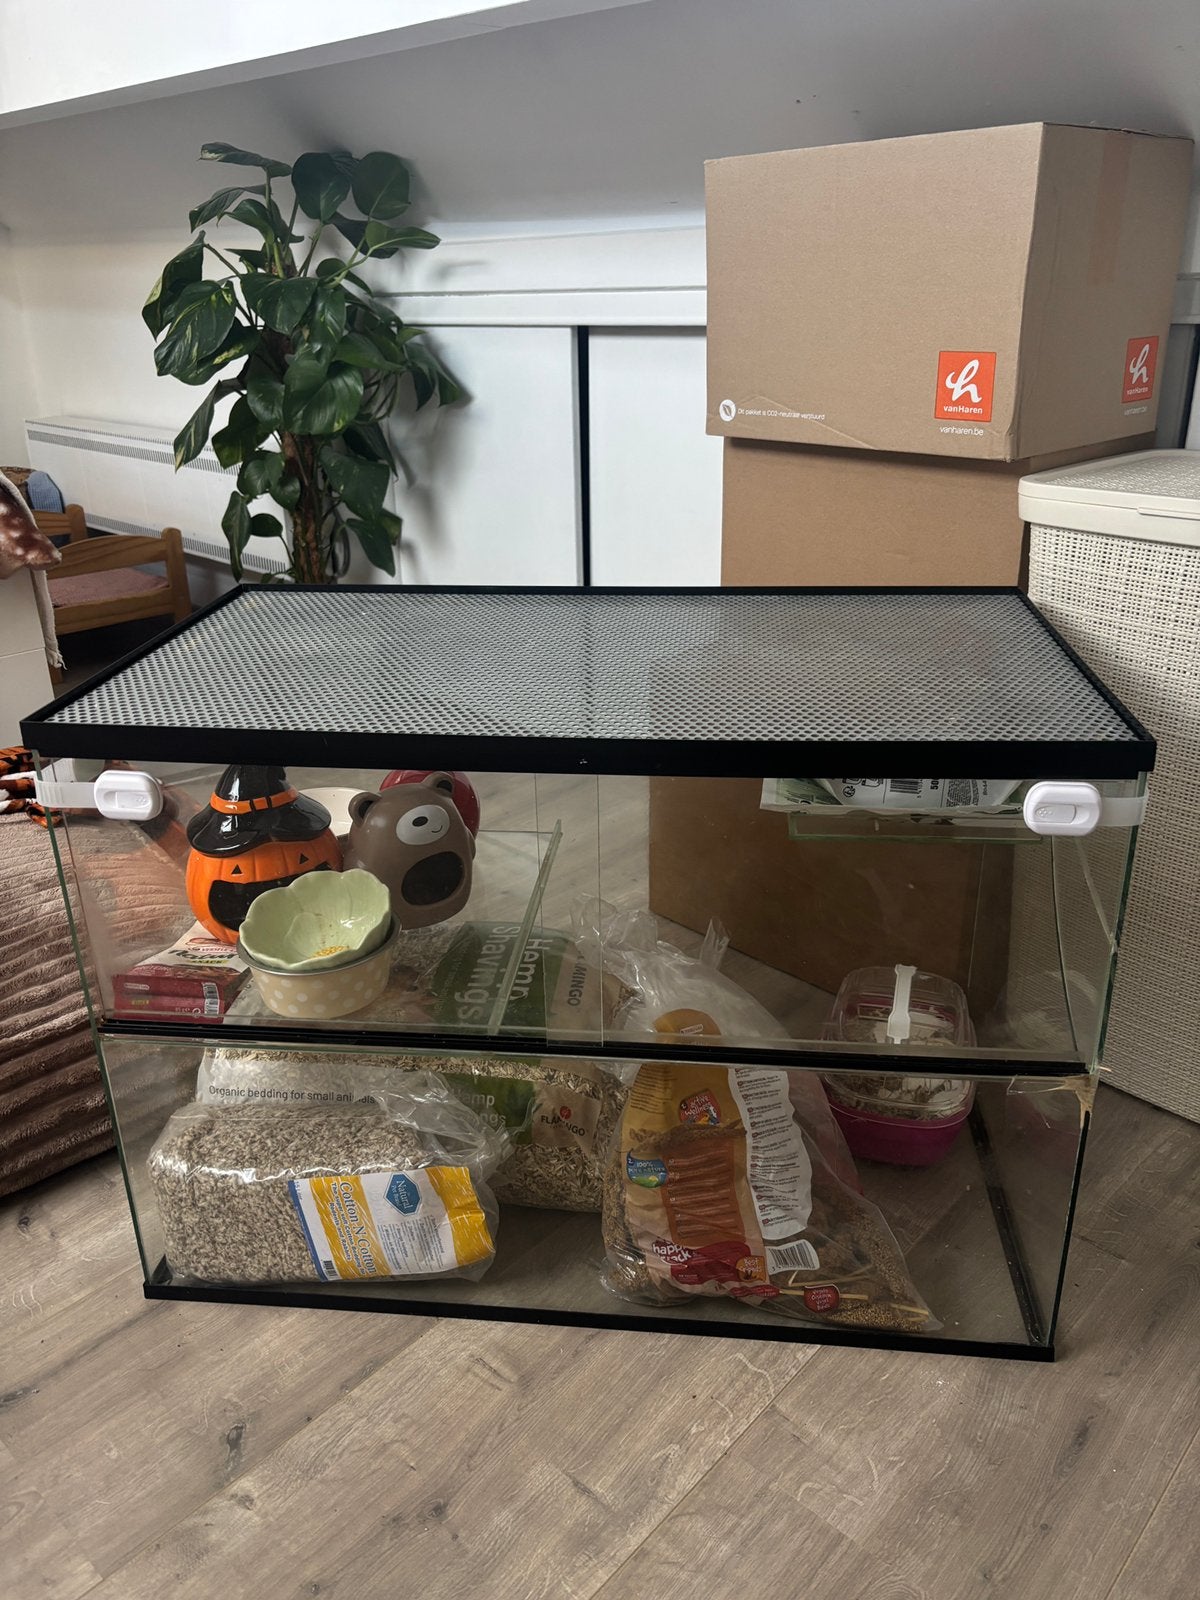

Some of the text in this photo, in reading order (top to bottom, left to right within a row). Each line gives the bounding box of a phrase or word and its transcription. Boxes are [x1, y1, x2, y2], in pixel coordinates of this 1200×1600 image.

[943, 404, 983, 415] vanHaren
[939, 425, 984, 436] vanharen.be
[209, 1086, 375, 1104] Organic bedding for small anials
[396, 1179, 413, 1209] Natural
[329, 1202, 339, 1226] Rodents
[341, 1239, 351, 1260] Rabbits
[335, 1195, 343, 1212] super
[345, 1225, 354, 1245] Cotton
[351, 1246, 362, 1268] Bedding
[340, 1182, 377, 1273] Cotton N Cotton
